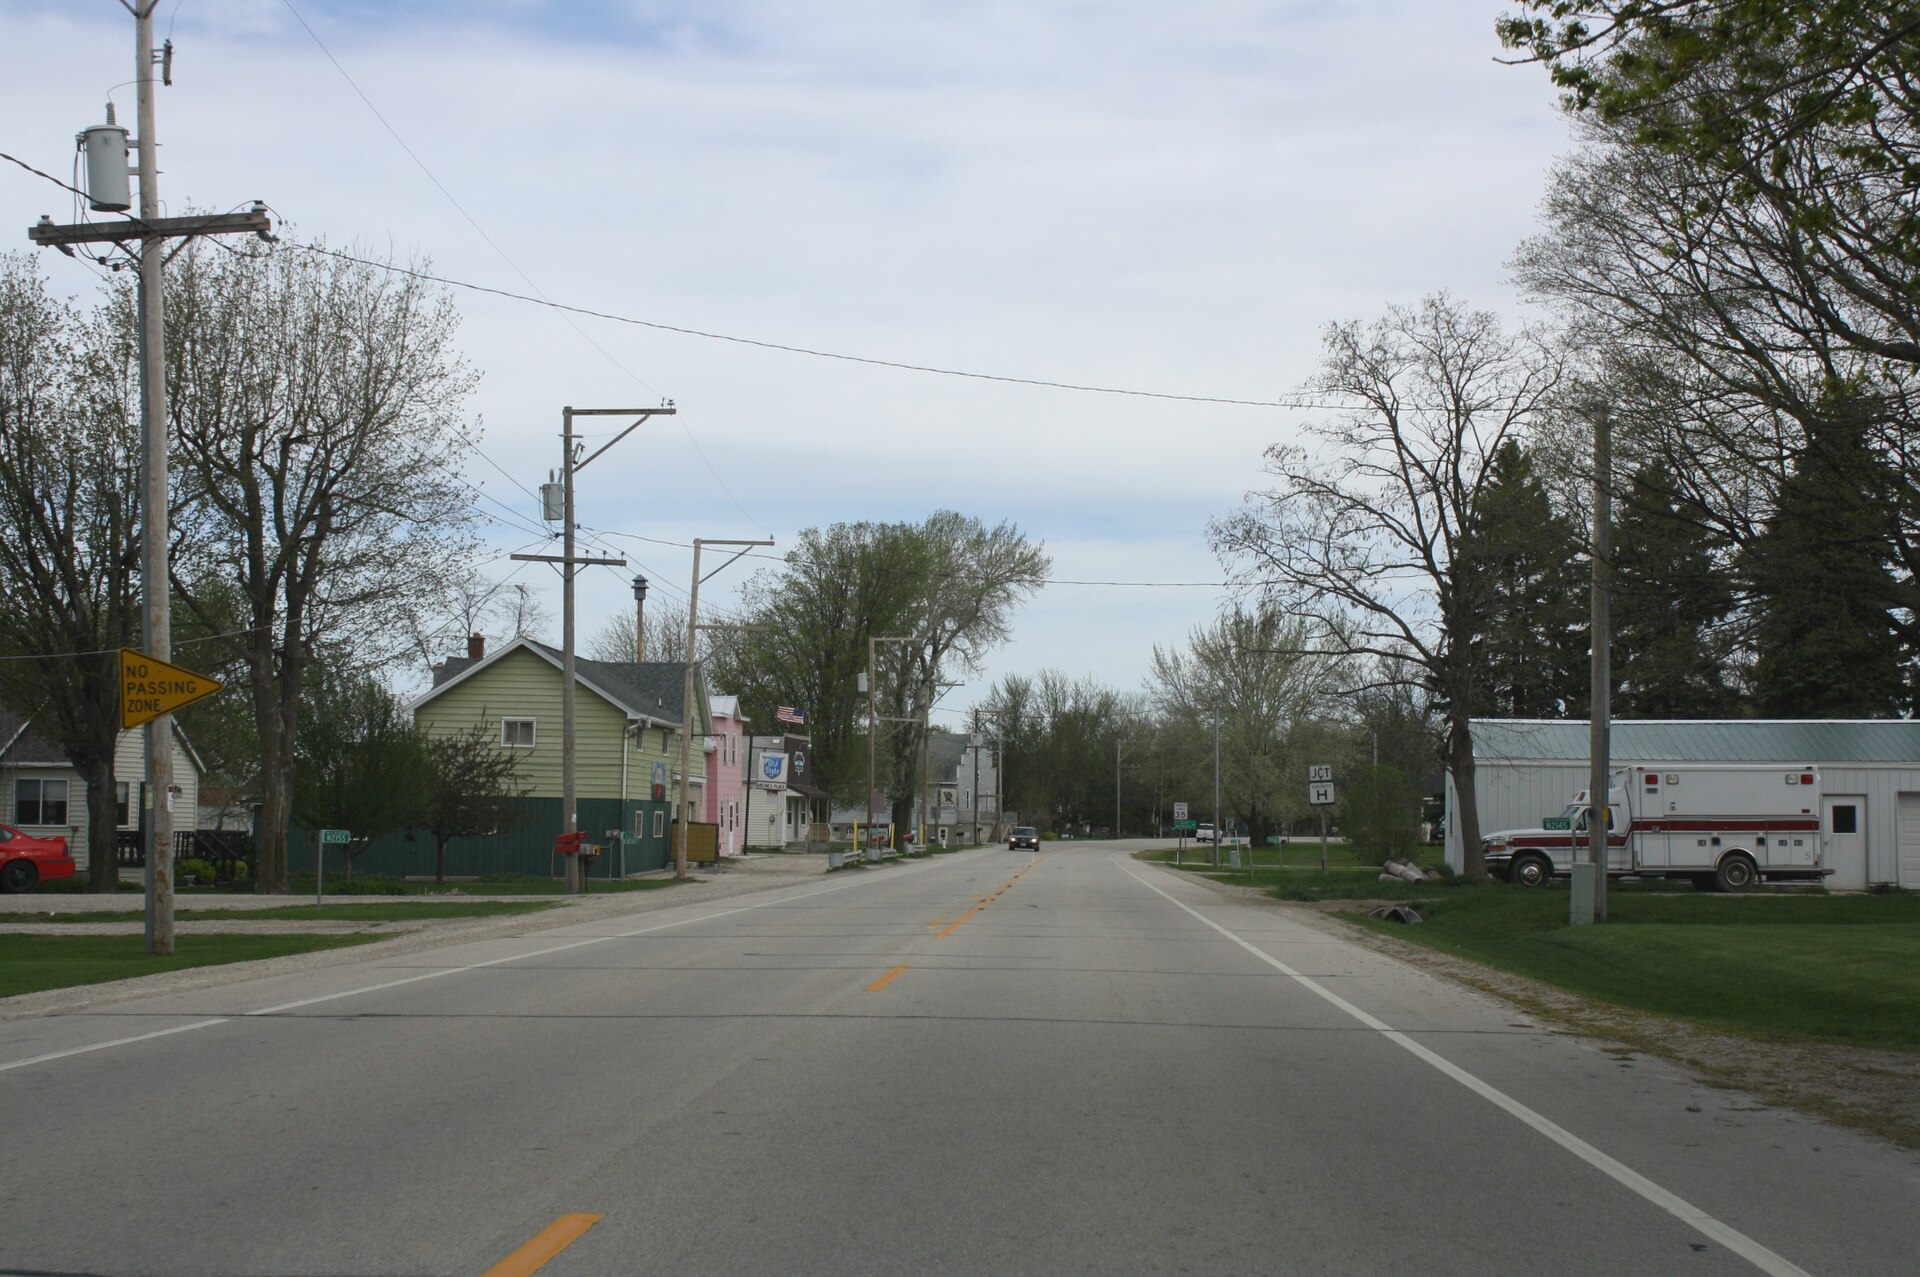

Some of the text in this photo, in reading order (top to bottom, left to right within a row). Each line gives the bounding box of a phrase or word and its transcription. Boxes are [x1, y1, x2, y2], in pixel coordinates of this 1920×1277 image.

[126, 664, 148, 678] NO
[127, 681, 196, 695] PASSING
[127, 699, 161, 712] ZONE
[765, 758, 778, 767] Old
[1312, 767, 1330, 779] JCT
[1317, 790, 1328, 800] H
[1546, 821, 1568, 829] N2145
